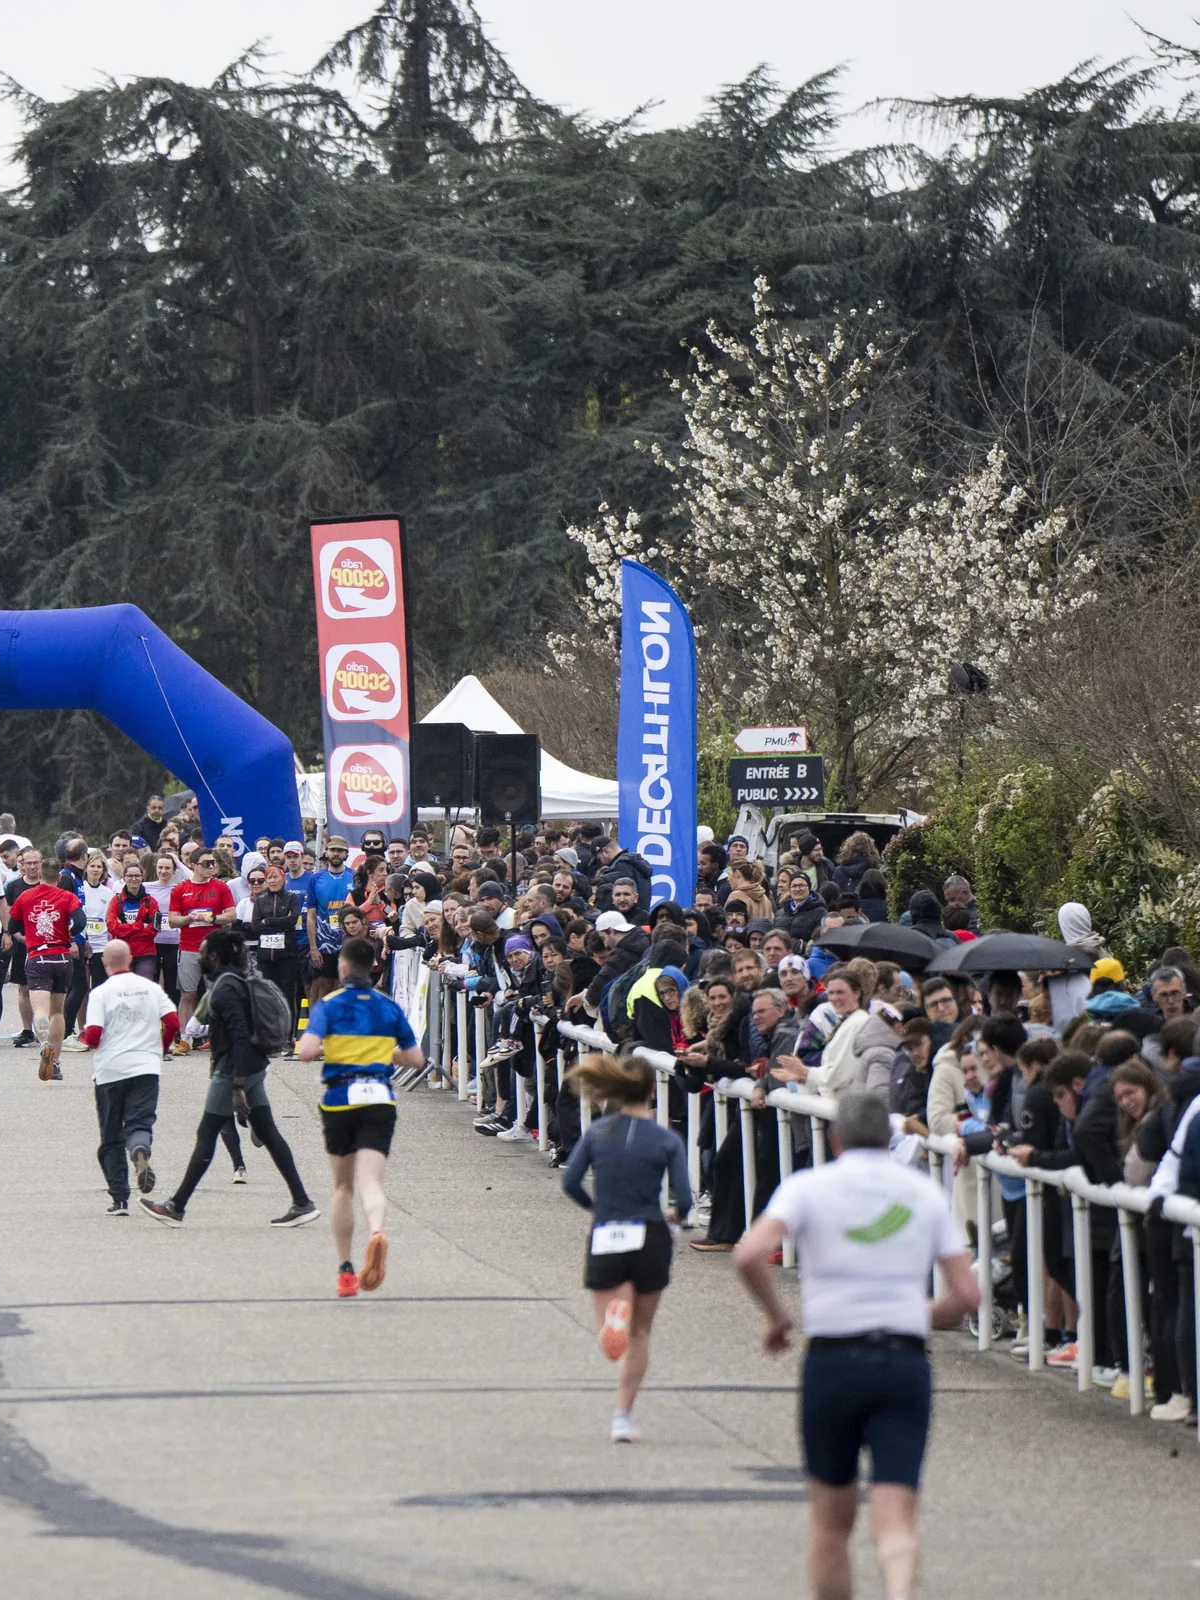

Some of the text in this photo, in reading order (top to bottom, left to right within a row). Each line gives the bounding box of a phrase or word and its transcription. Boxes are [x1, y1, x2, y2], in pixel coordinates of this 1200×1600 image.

[764, 737, 787, 746] PMU
[746, 763, 808, 780] ENTRÉE B
[737, 787, 778, 801] PUBLIC
